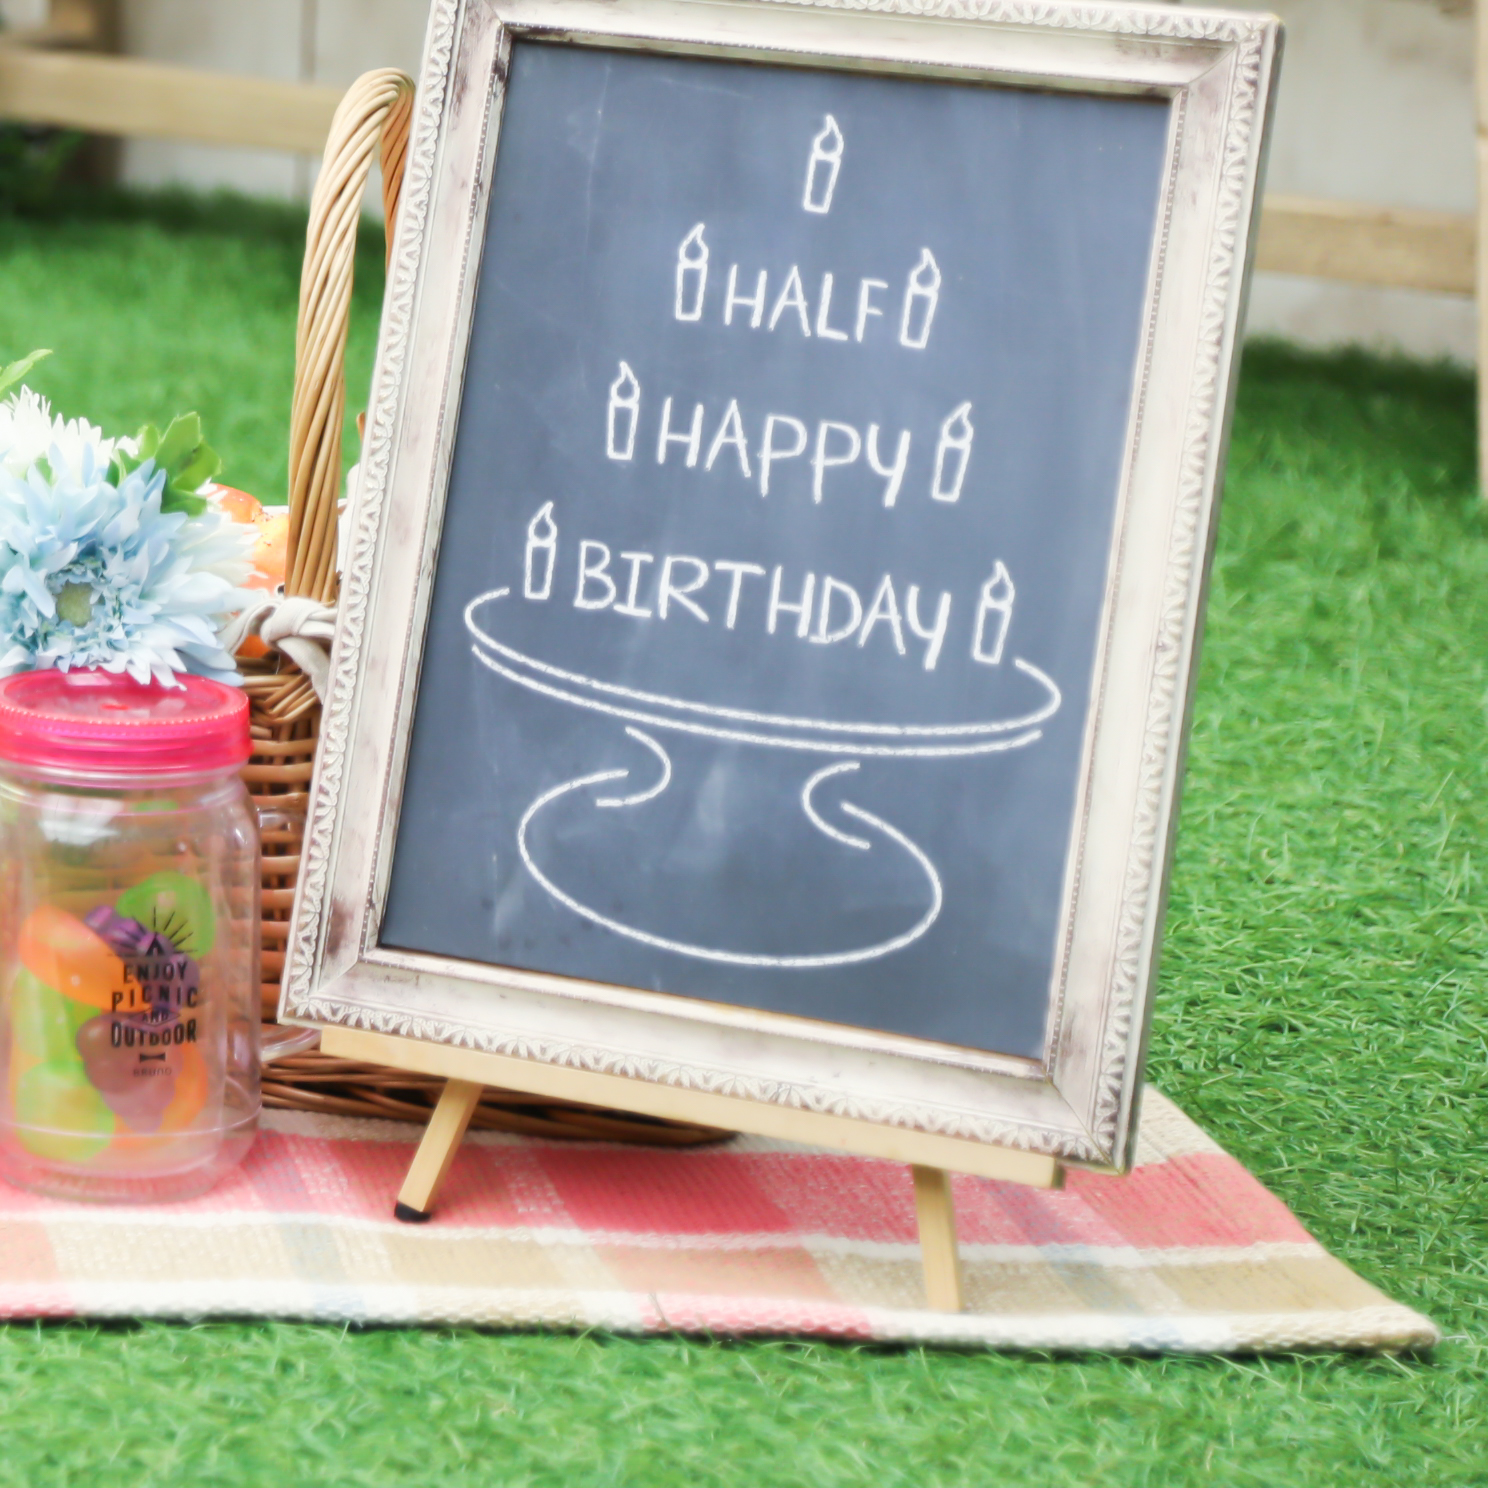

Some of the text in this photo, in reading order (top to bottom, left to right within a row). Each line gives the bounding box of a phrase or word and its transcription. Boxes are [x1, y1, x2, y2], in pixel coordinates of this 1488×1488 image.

[723, 264, 889, 344] HALF
[656, 396, 913, 508] HAPPY
[573, 538, 952, 671] BIRTHDAY
[123, 961, 188, 984] ENJOY
[112, 984, 198, 1013] PICNIC
[142, 1007, 170, 1023] AND
[111, 1019, 197, 1048] OUTDOOR
